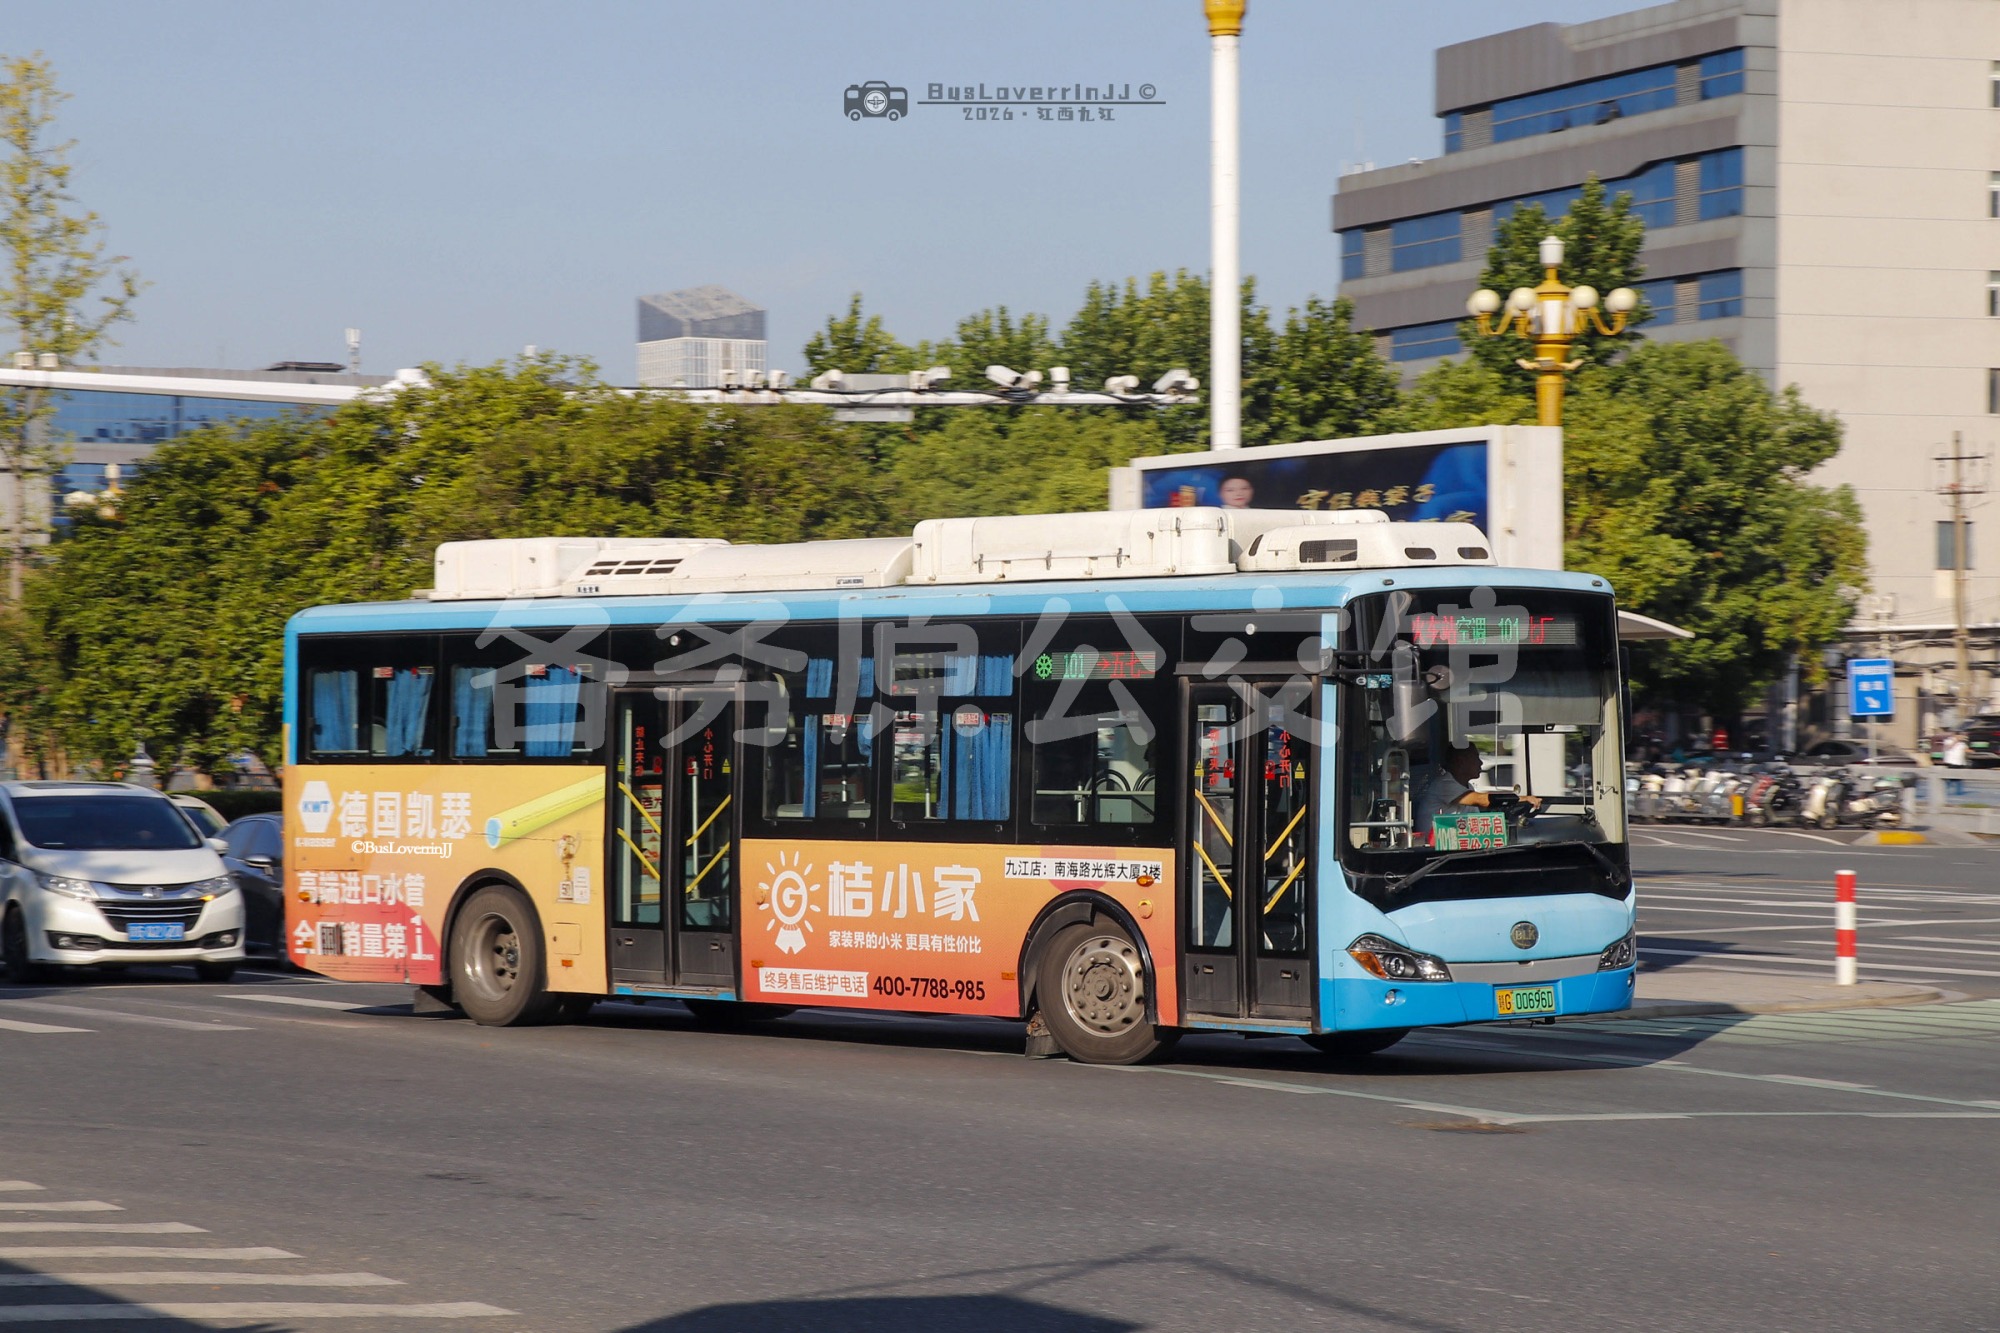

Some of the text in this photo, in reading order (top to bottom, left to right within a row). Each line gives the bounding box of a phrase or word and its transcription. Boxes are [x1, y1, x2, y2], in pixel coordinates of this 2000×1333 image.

[1063, 653, 1086, 679] 101
[338, 790, 472, 840] 德国凯瑟
[1456, 815, 1505, 836] 空调开启
[296, 871, 425, 907] 高端进口水管
[828, 860, 981, 923] 桔小家
[829, 930, 982, 954] 家装界的小米 更具有性价比
[764, 971, 866, 994] 终身售后维护电话
[873, 975, 986, 1001] 400-7788-985
